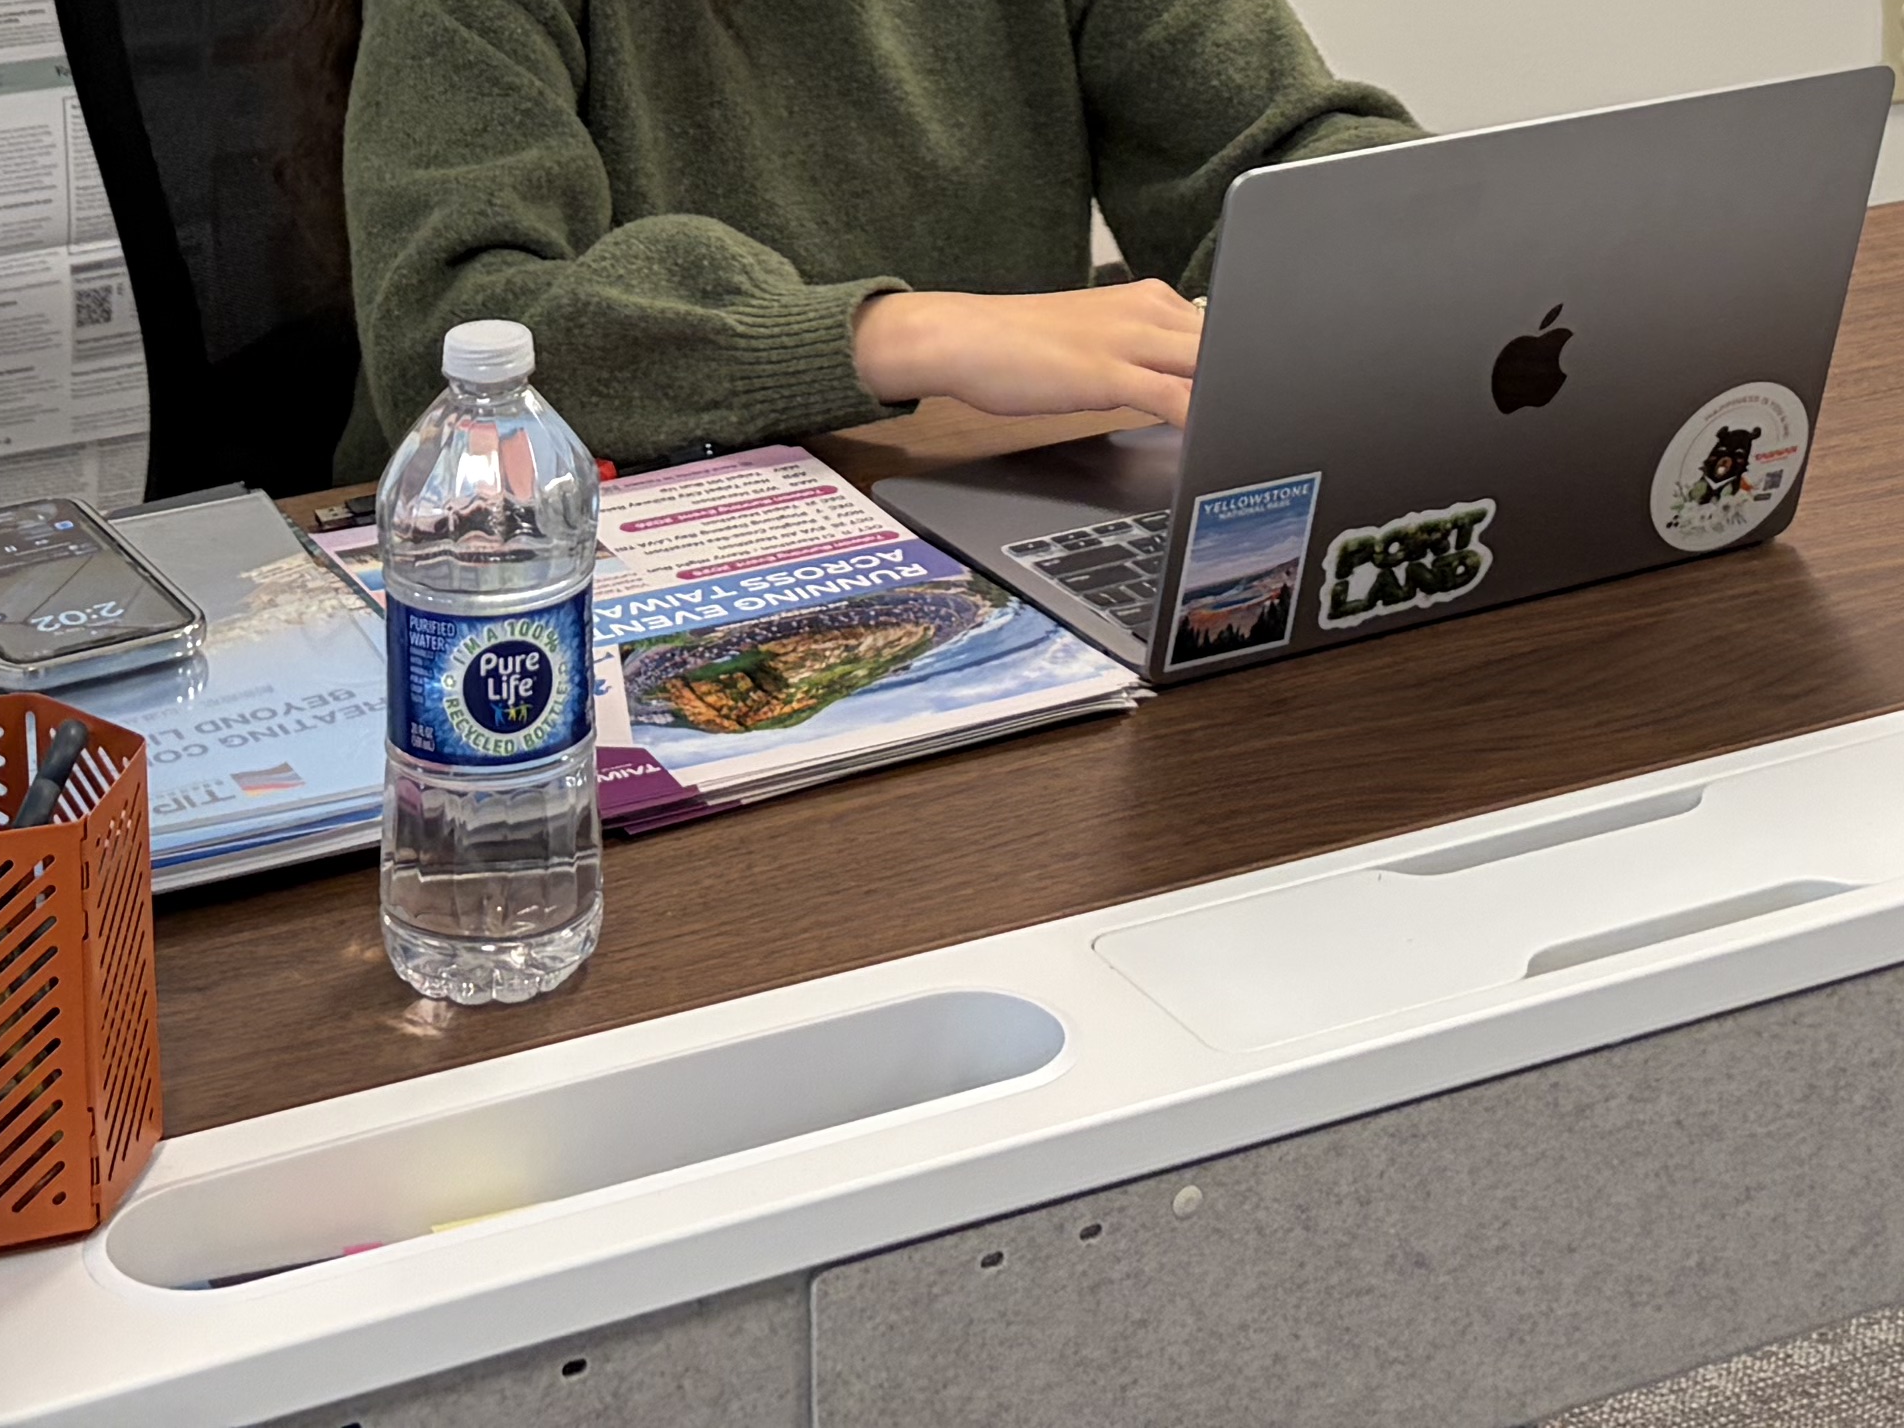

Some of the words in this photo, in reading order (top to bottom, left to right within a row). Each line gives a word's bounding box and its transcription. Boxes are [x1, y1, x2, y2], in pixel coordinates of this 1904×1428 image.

[1204, 483, 1311, 514] YELLOWSTONE
[1218, 504, 1264, 520] NATIONAL
[1267, 499, 1291, 513] PARK
[1335, 507, 1488, 579] PORT
[733, 561, 928, 613] RUNNING
[739, 548, 904, 592] ACROSS
[1328, 549, 1484, 620] LAND
[31, 599, 125, 633] 2:02
[594, 585, 738, 623] TAIWA
[409, 615, 456, 636] PURIFIED
[486, 628, 498, 642] A
[505, 619, 560, 654] 100%
[593, 603, 729, 642] EVENT
[409, 631, 446, 651] WATER
[480, 652, 540, 677] Pure
[487, 676, 533, 705] Life
[195, 687, 357, 738] BEYOND
[445, 697, 515, 755] RECYCLED
[523, 681, 569, 750] BOTTLE
